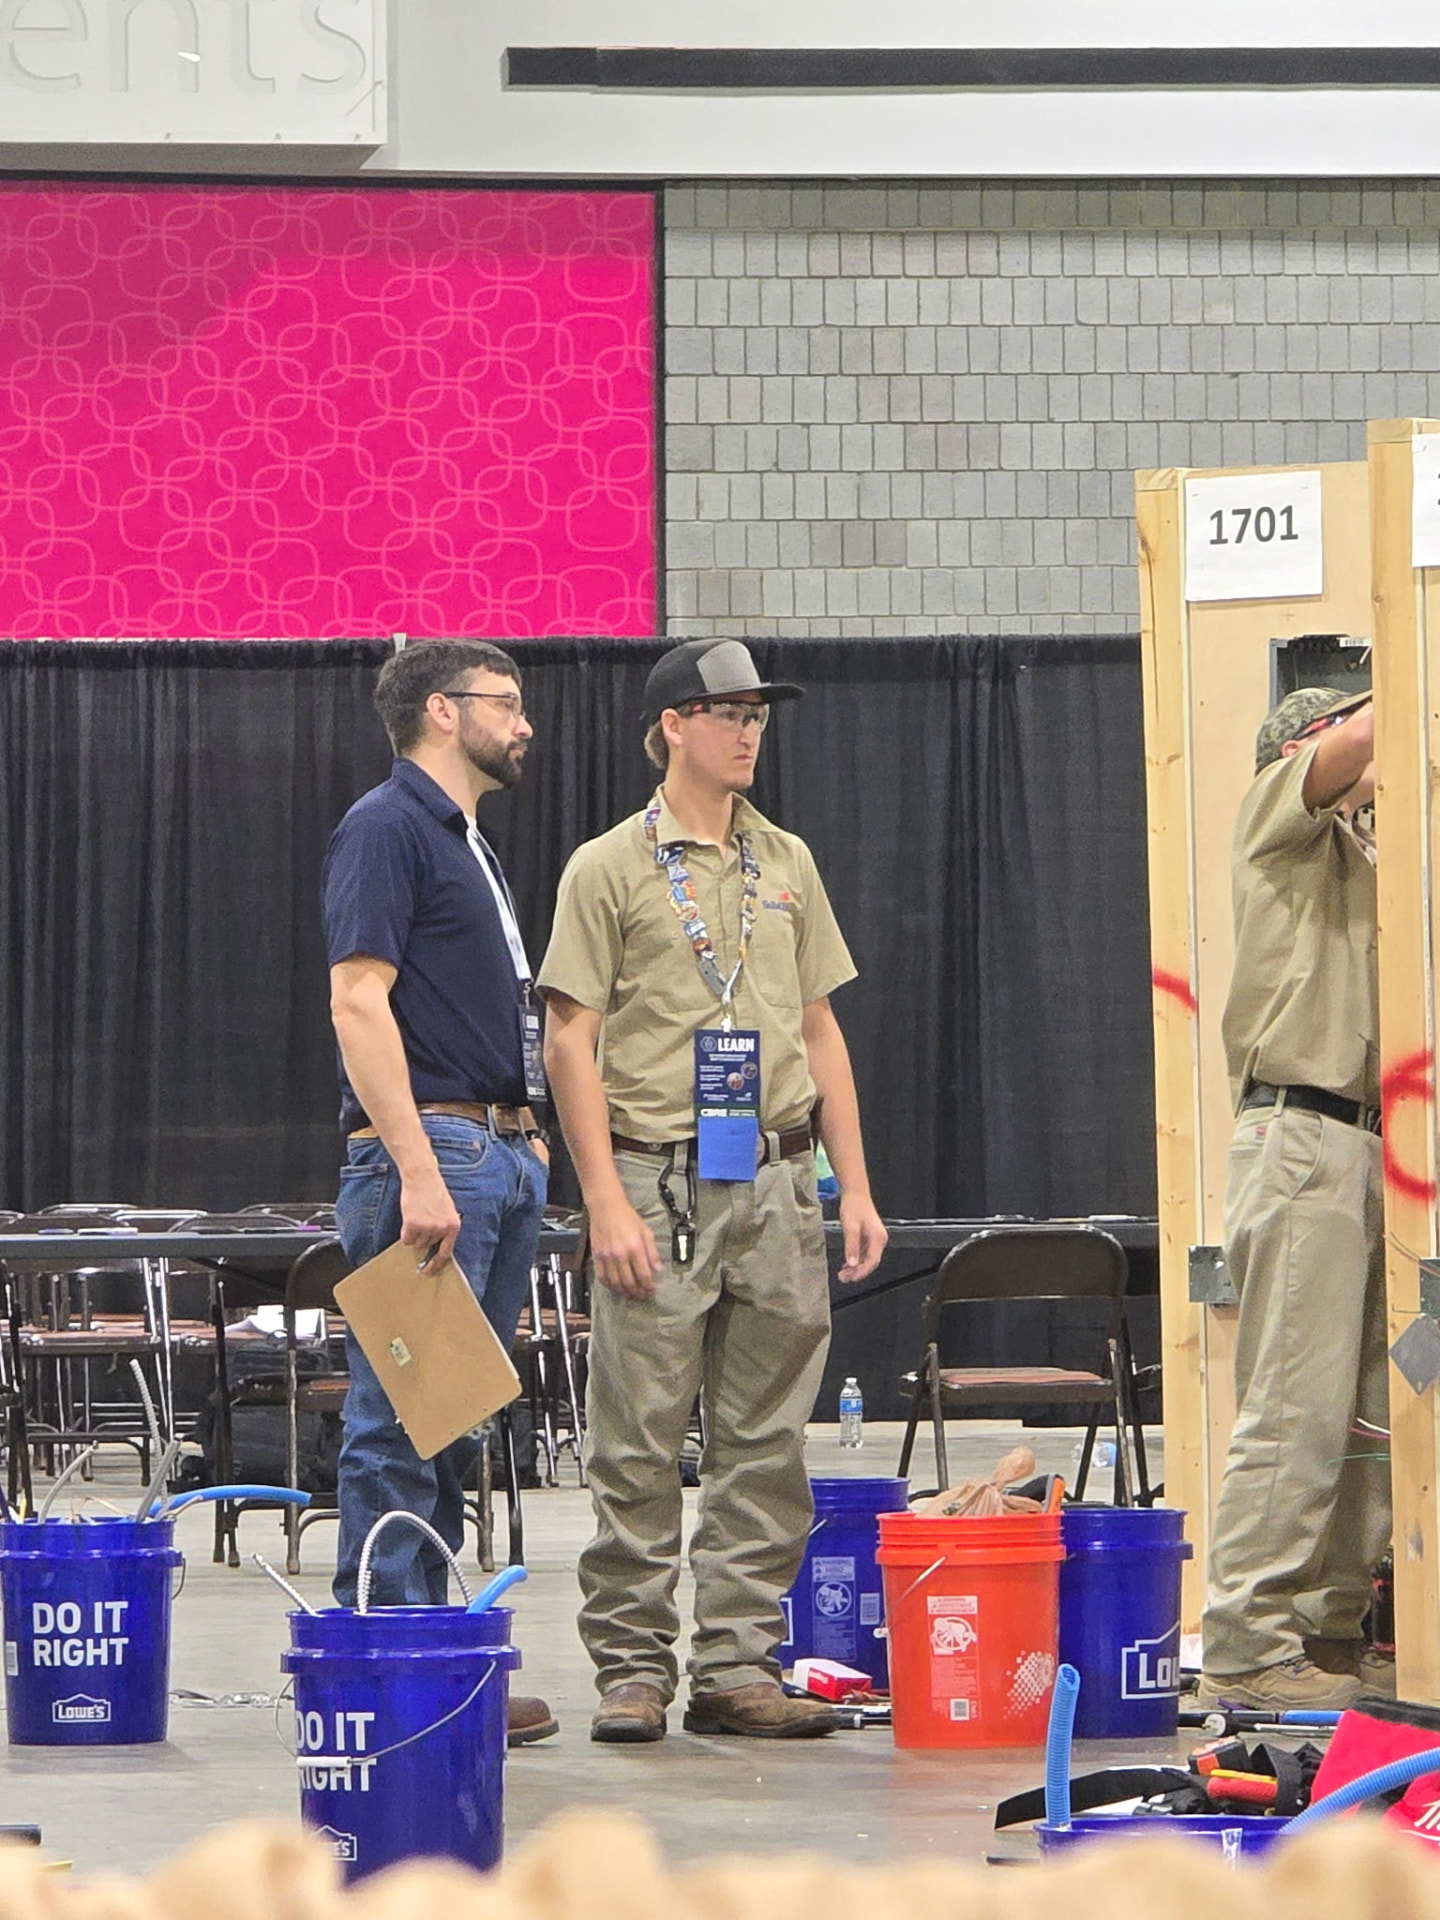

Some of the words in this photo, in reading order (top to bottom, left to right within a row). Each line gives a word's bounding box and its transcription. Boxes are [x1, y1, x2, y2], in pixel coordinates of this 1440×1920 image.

[1209, 505, 1299, 546] 1701
[717, 1037, 755, 1052] LEARN
[32, 1602, 82, 1634] DO
[94, 1601, 129, 1633] IT
[33, 1637, 130, 1666] RIGHT
[335, 1711, 375, 1751] IT
